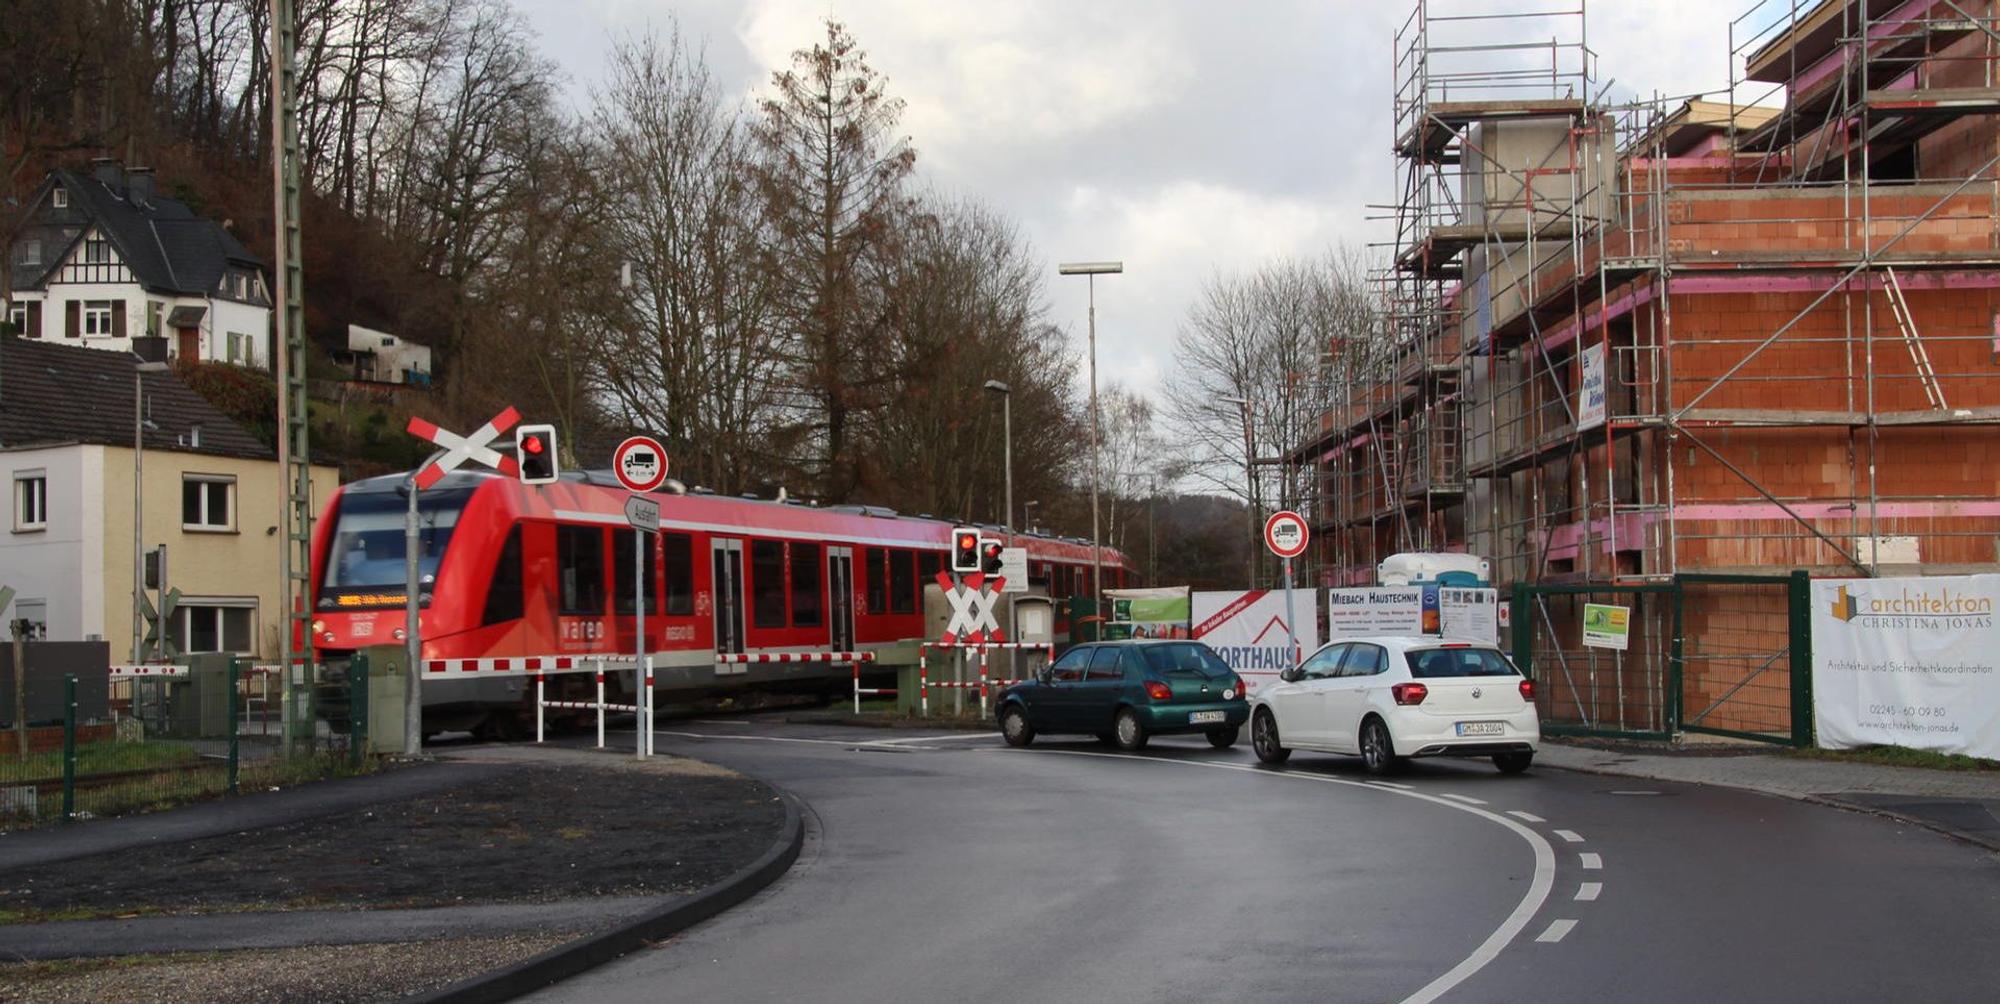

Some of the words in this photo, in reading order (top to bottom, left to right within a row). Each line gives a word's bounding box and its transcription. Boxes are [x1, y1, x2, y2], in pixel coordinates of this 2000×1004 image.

[1331, 592, 1365, 605] MIEBACH
[1368, 591, 1419, 605] HAUSTECHNIK
[1870, 587, 1991, 613] architekton
[1862, 616, 1939, 629] CHRISTINA
[1945, 616, 1992, 631] JONAS
[1827, 659, 1870, 672] Architektur
[1871, 662, 1888, 674] und
[1888, 661, 1993, 675] Sicherheitskoordination
[1869, 704, 1896, 717] 02245
[1857, 720, 1960, 734] www.architekton-jonas.de
